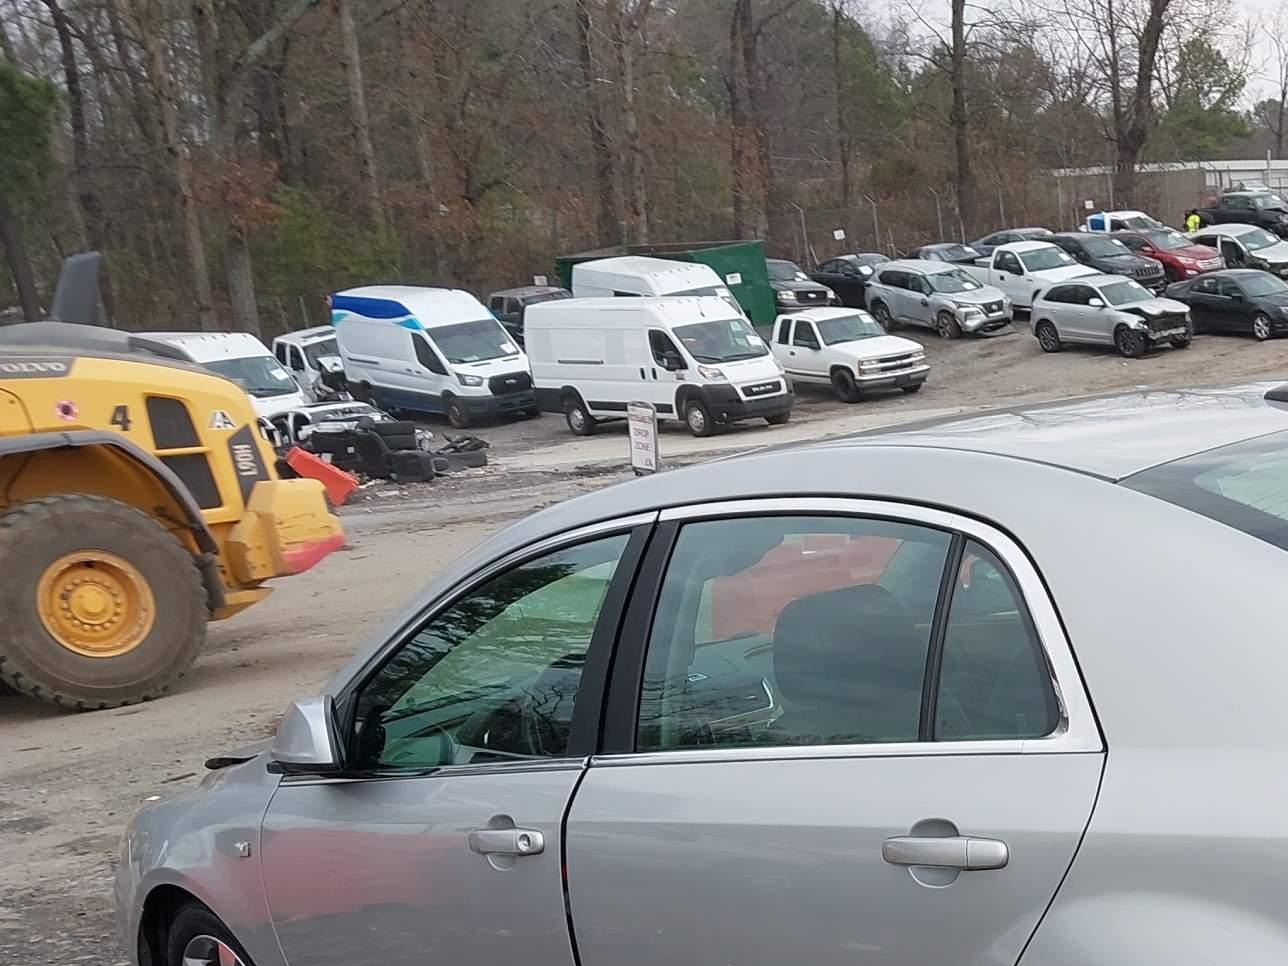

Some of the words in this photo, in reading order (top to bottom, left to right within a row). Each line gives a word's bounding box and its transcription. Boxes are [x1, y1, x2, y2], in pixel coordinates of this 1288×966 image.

[0, 362, 67, 373] OLVO
[111, 405, 133, 432] 4
[231, 444, 259, 476] L90H
